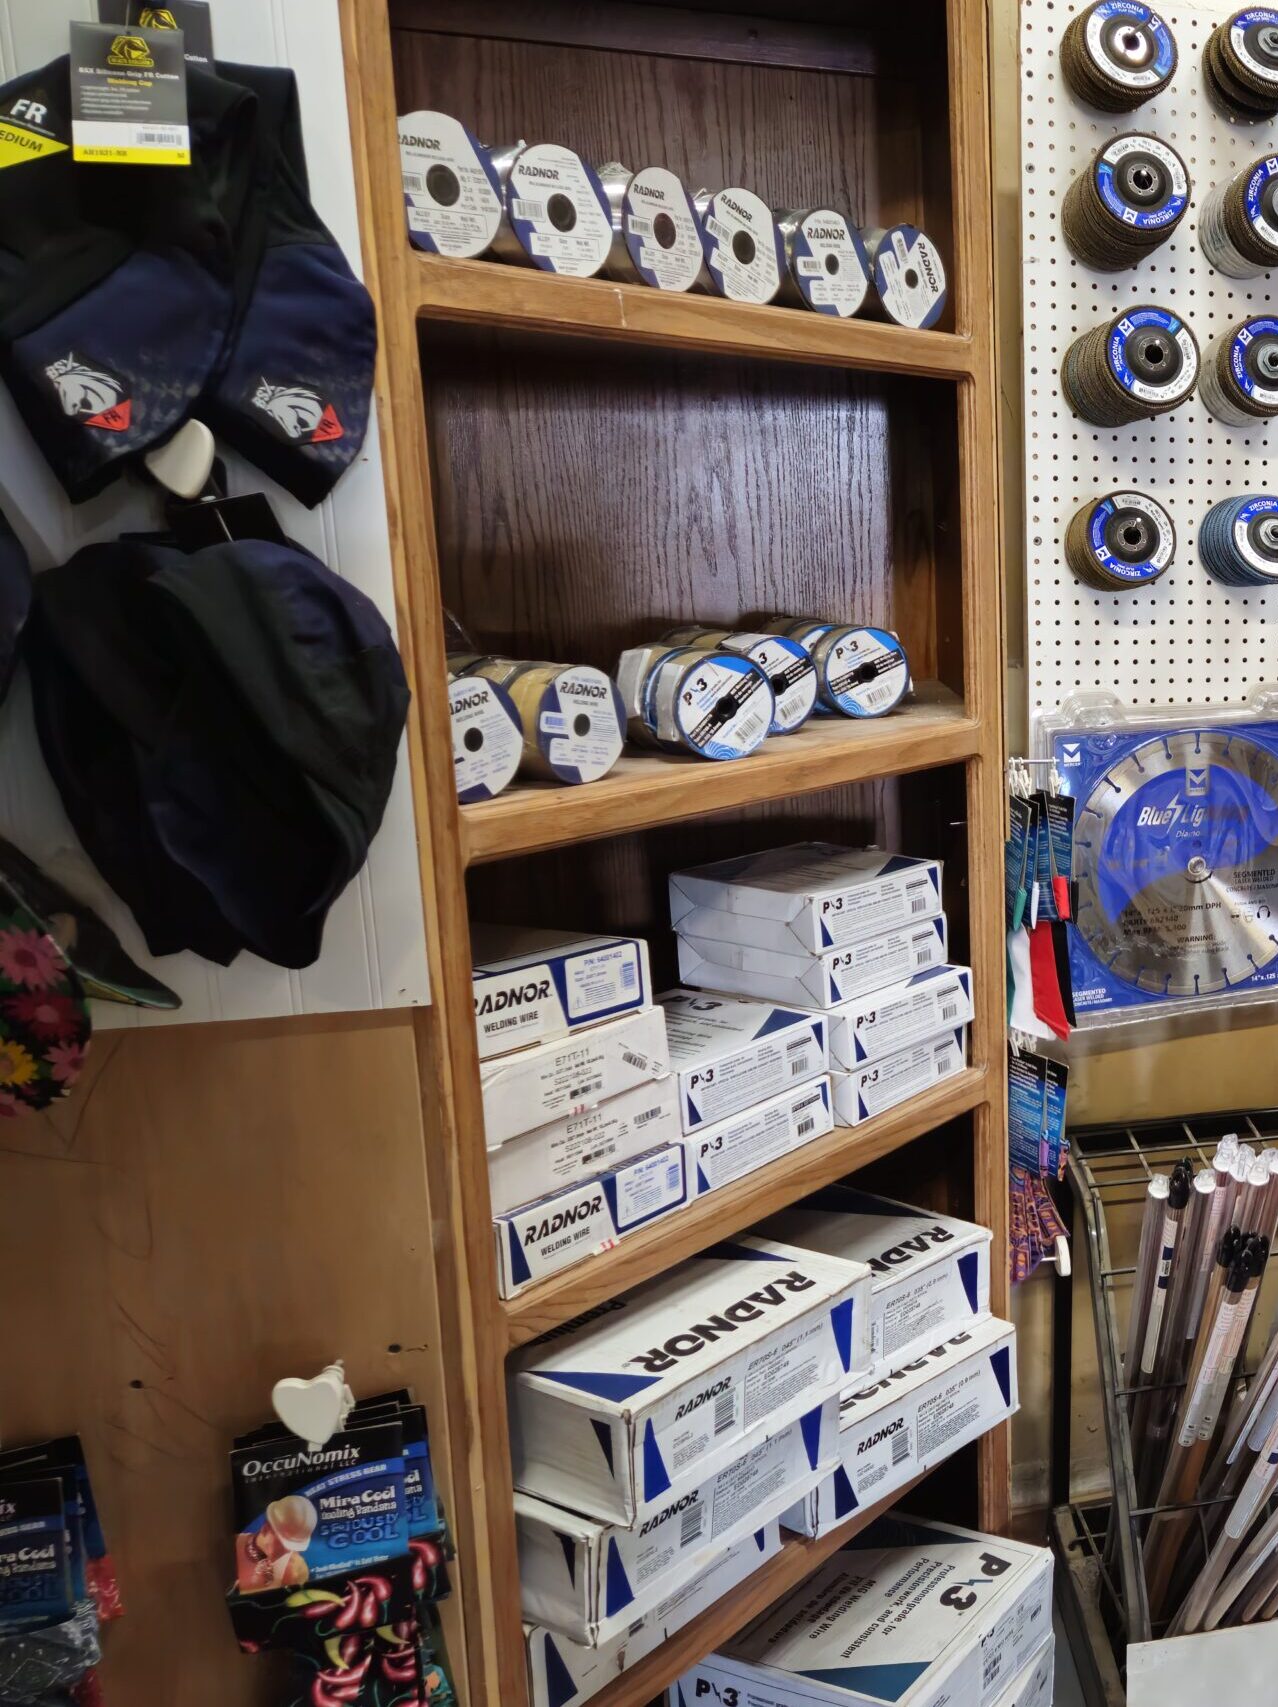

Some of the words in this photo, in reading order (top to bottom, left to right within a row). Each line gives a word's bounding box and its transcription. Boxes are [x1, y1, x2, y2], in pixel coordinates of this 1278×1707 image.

[1111, 2, 1145, 15] ZIRCONIA
[1244, 11, 1276, 20] ZIRCONIA
[10, 98, 47, 124] FR
[518, 164, 559, 180] RADNOR
[633, 183, 665, 200] RADNOR
[1248, 169, 1265, 202] ZIRCONIA
[720, 194, 753, 222] RADNOR
[1143, 208, 1175, 226] ZIRCONIA
[807, 226, 845, 241] RADNOR
[918, 242, 939, 294] RADNOR
[1112, 336, 1122, 372] ZIRCONIA
[1231, 345, 1243, 378] ZIRCONIA
[1248, 500, 1278, 510] ZIRCONIA
[1109, 561, 1141, 577] ZIRCONIA
[560, 681, 607, 699] RADNOR
[1137, 806, 1172, 826] Blue
[1233, 869, 1275, 878] SEGMENTED
[484, 1016, 517, 1033] WELDING
[519, 1011, 539, 1025] WIRE
[524, 1195, 602, 1246] RADNOR
[540, 1237, 572, 1256] WELDING
[573, 1226, 591, 1242] WIRE
[628, 1270, 818, 1373] RADNOR
[747, 1346, 779, 1371] ER70S-6
[675, 1376, 732, 1421] RADNOR
[917, 1391, 942, 1413] ER70S-6
[857, 1417, 904, 1456] RADNOR
[242, 1444, 361, 1477] OccuNomix
[638, 1489, 699, 1538] RADNOR
[327, 1525, 399, 1549] COOL
[857, 1578, 876, 1595] MIG
[884, 1557, 930, 1598] Performance
[908, 1560, 943, 1595] Precision
[828, 1593, 860, 1622] Welding
[809, 1619, 830, 1640] Wire
[840, 1621, 879, 1659] consistent
